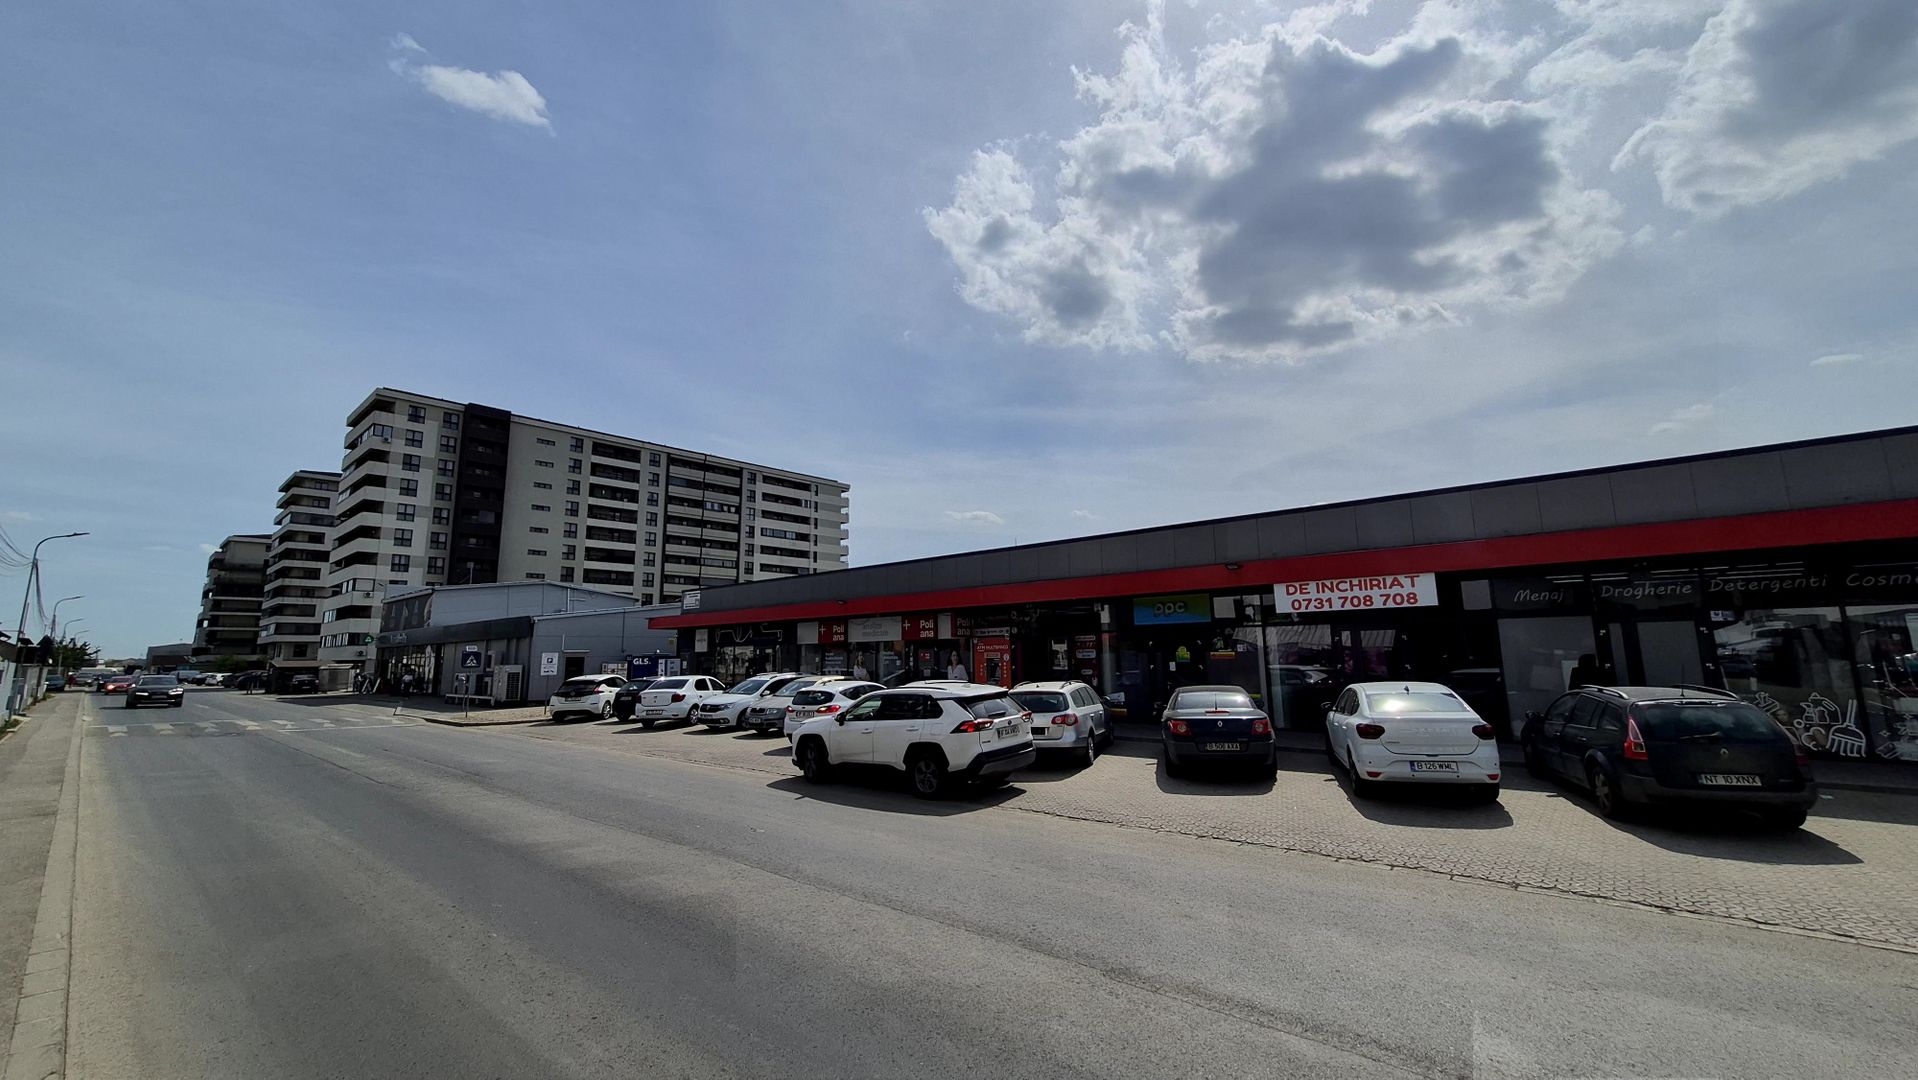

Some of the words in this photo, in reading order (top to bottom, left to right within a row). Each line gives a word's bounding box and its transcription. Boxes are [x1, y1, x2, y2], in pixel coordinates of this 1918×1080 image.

[1285, 583, 1310, 596] DE
[1316, 575, 1420, 594] INCHIRIAT
[1707, 573, 1827, 593] Detergenti
[1513, 588, 1565, 603] Menaj
[1600, 582, 1693, 600] Drogherie
[1291, 597, 1333, 611] 0731
[1338, 594, 1374, 609] 708
[1379, 592, 1419, 607] 708
[920, 619, 934, 629] Poli
[957, 617, 971, 627] Poli
[832, 624, 845, 633] Poli
[957, 628, 971, 636] ana
[920, 630, 934, 638] ana
[1416, 761, 1423, 770] B
[1424, 762, 1437, 770] 126
[1704, 775, 1718, 784] NT
[1722, 775, 1733, 784] 10
[1733, 775, 1758, 784] XNX
